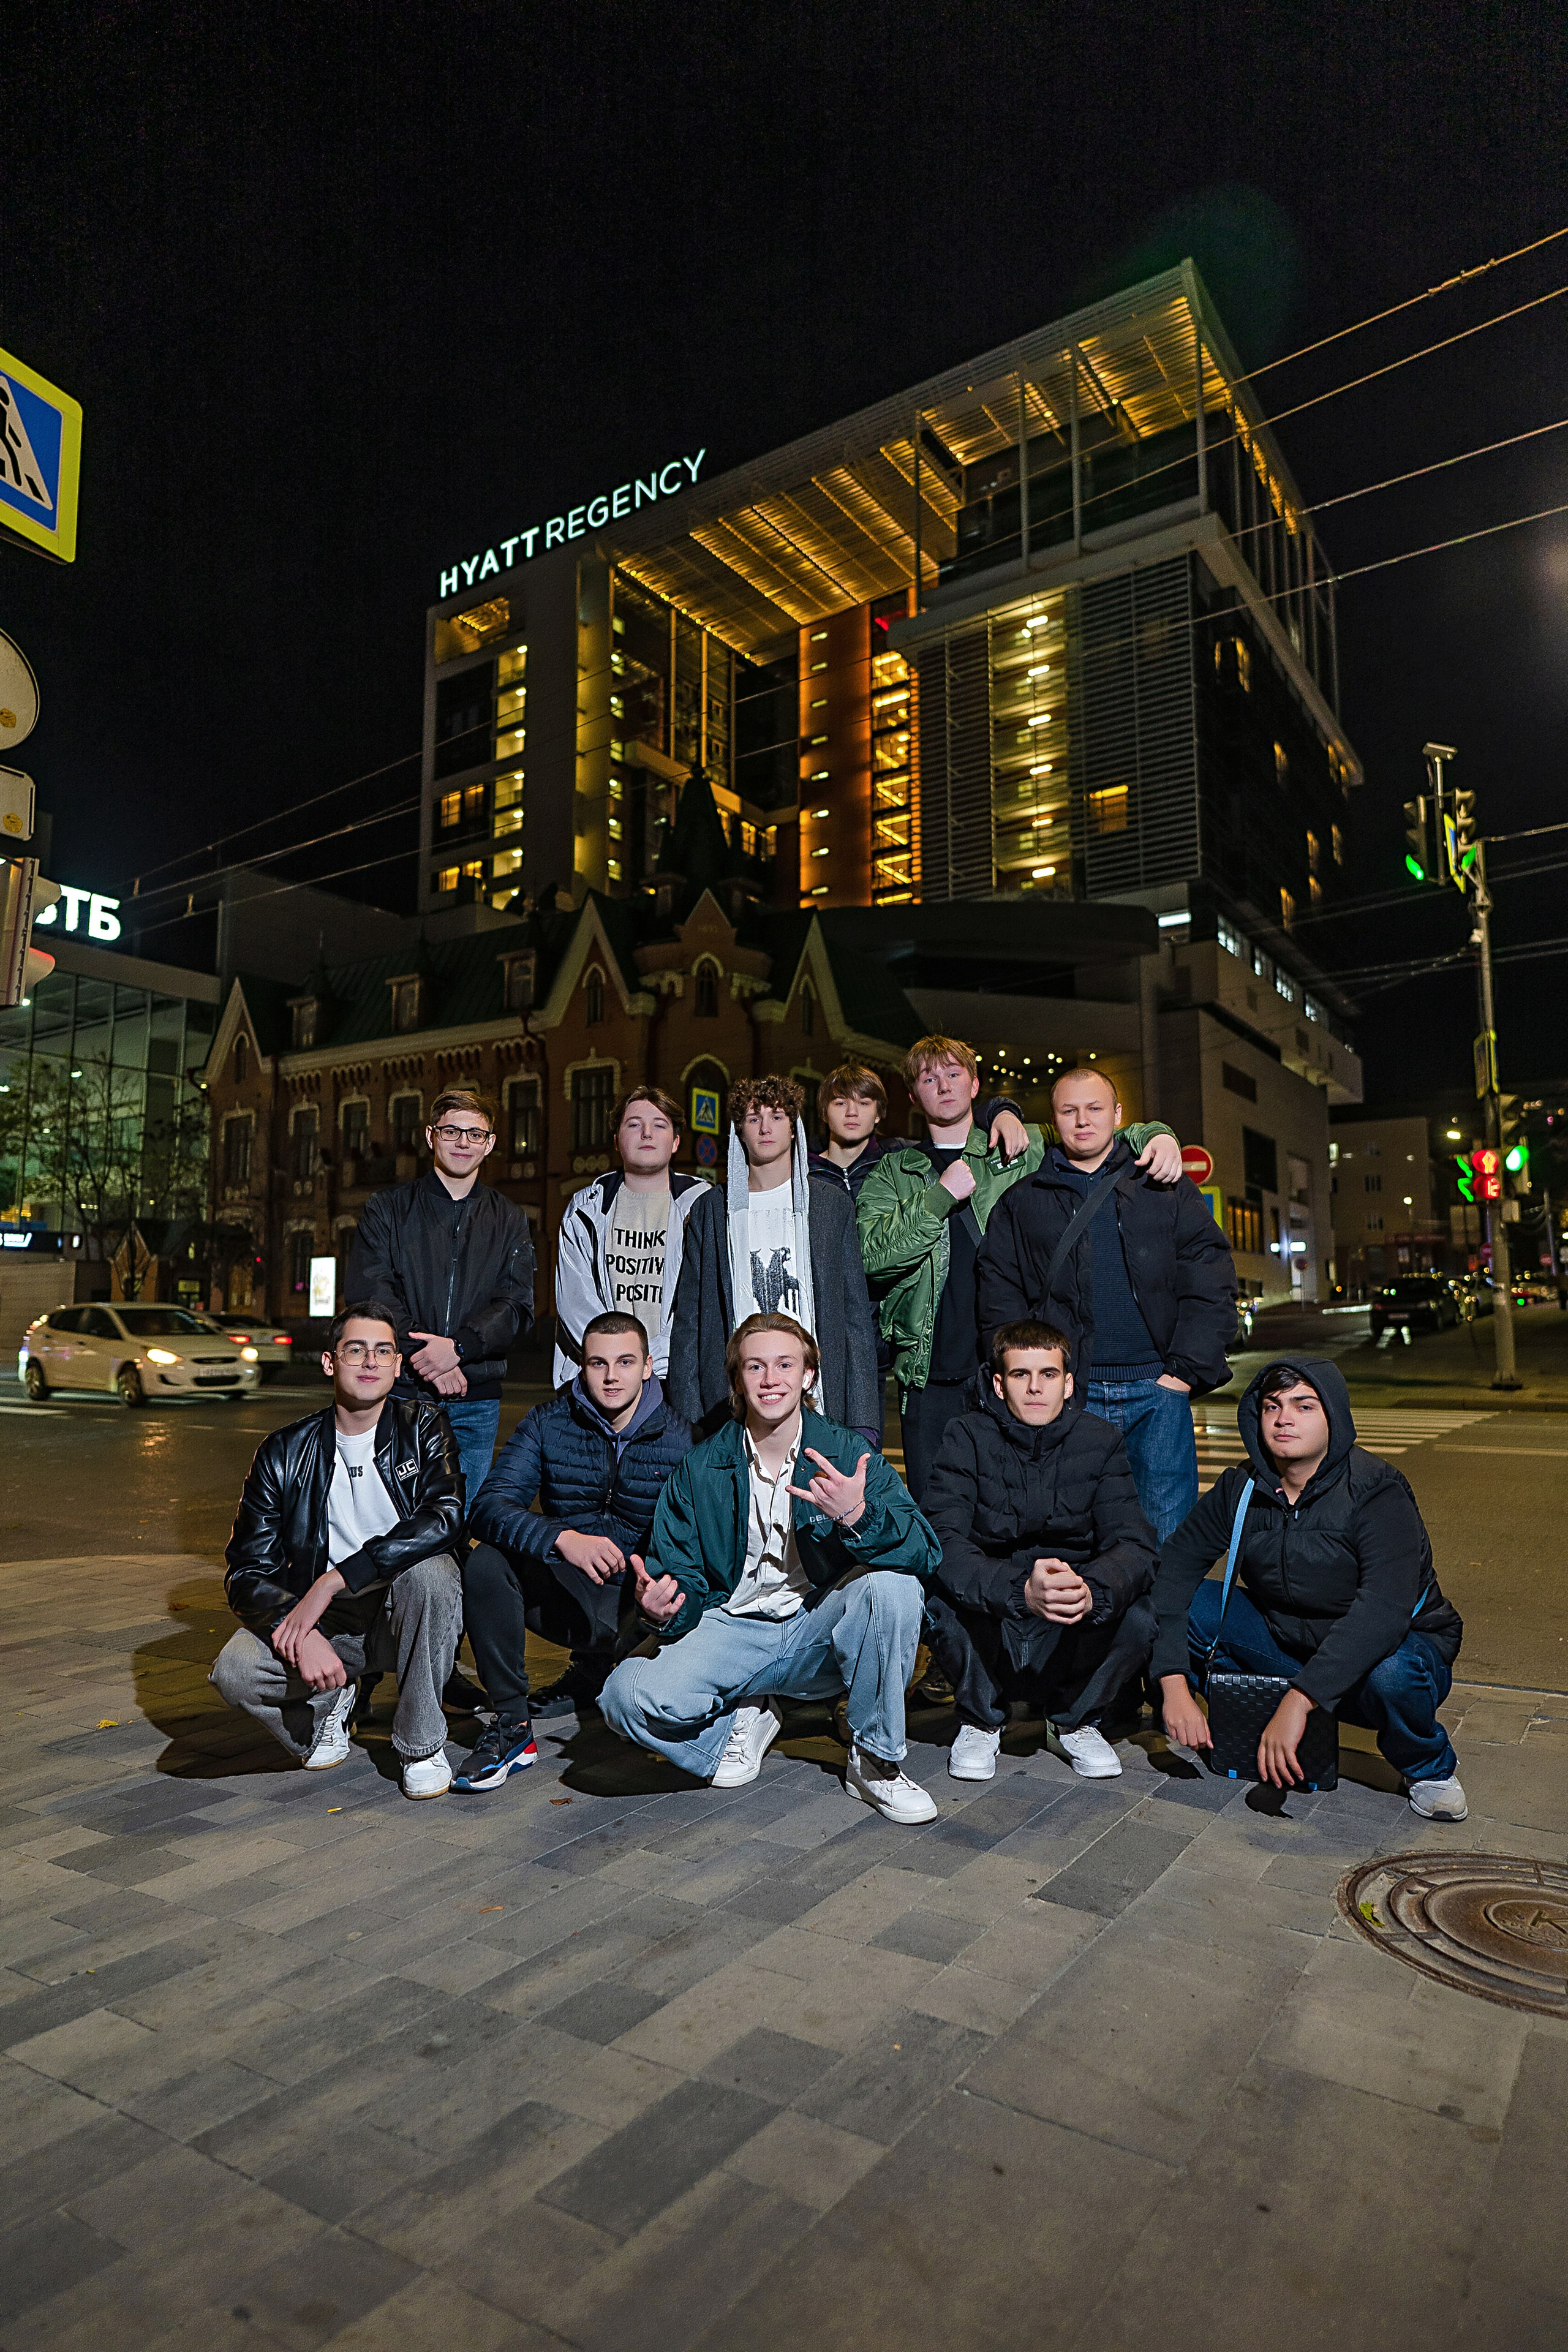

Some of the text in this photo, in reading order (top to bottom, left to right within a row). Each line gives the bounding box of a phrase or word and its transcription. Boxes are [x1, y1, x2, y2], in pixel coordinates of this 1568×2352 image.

[440, 448, 707, 598] HYATT REGENCY
[614, 1227, 666, 1250] THINK
[605, 1254, 665, 1276] POSITIV
[349, 1465, 363, 1478] US
